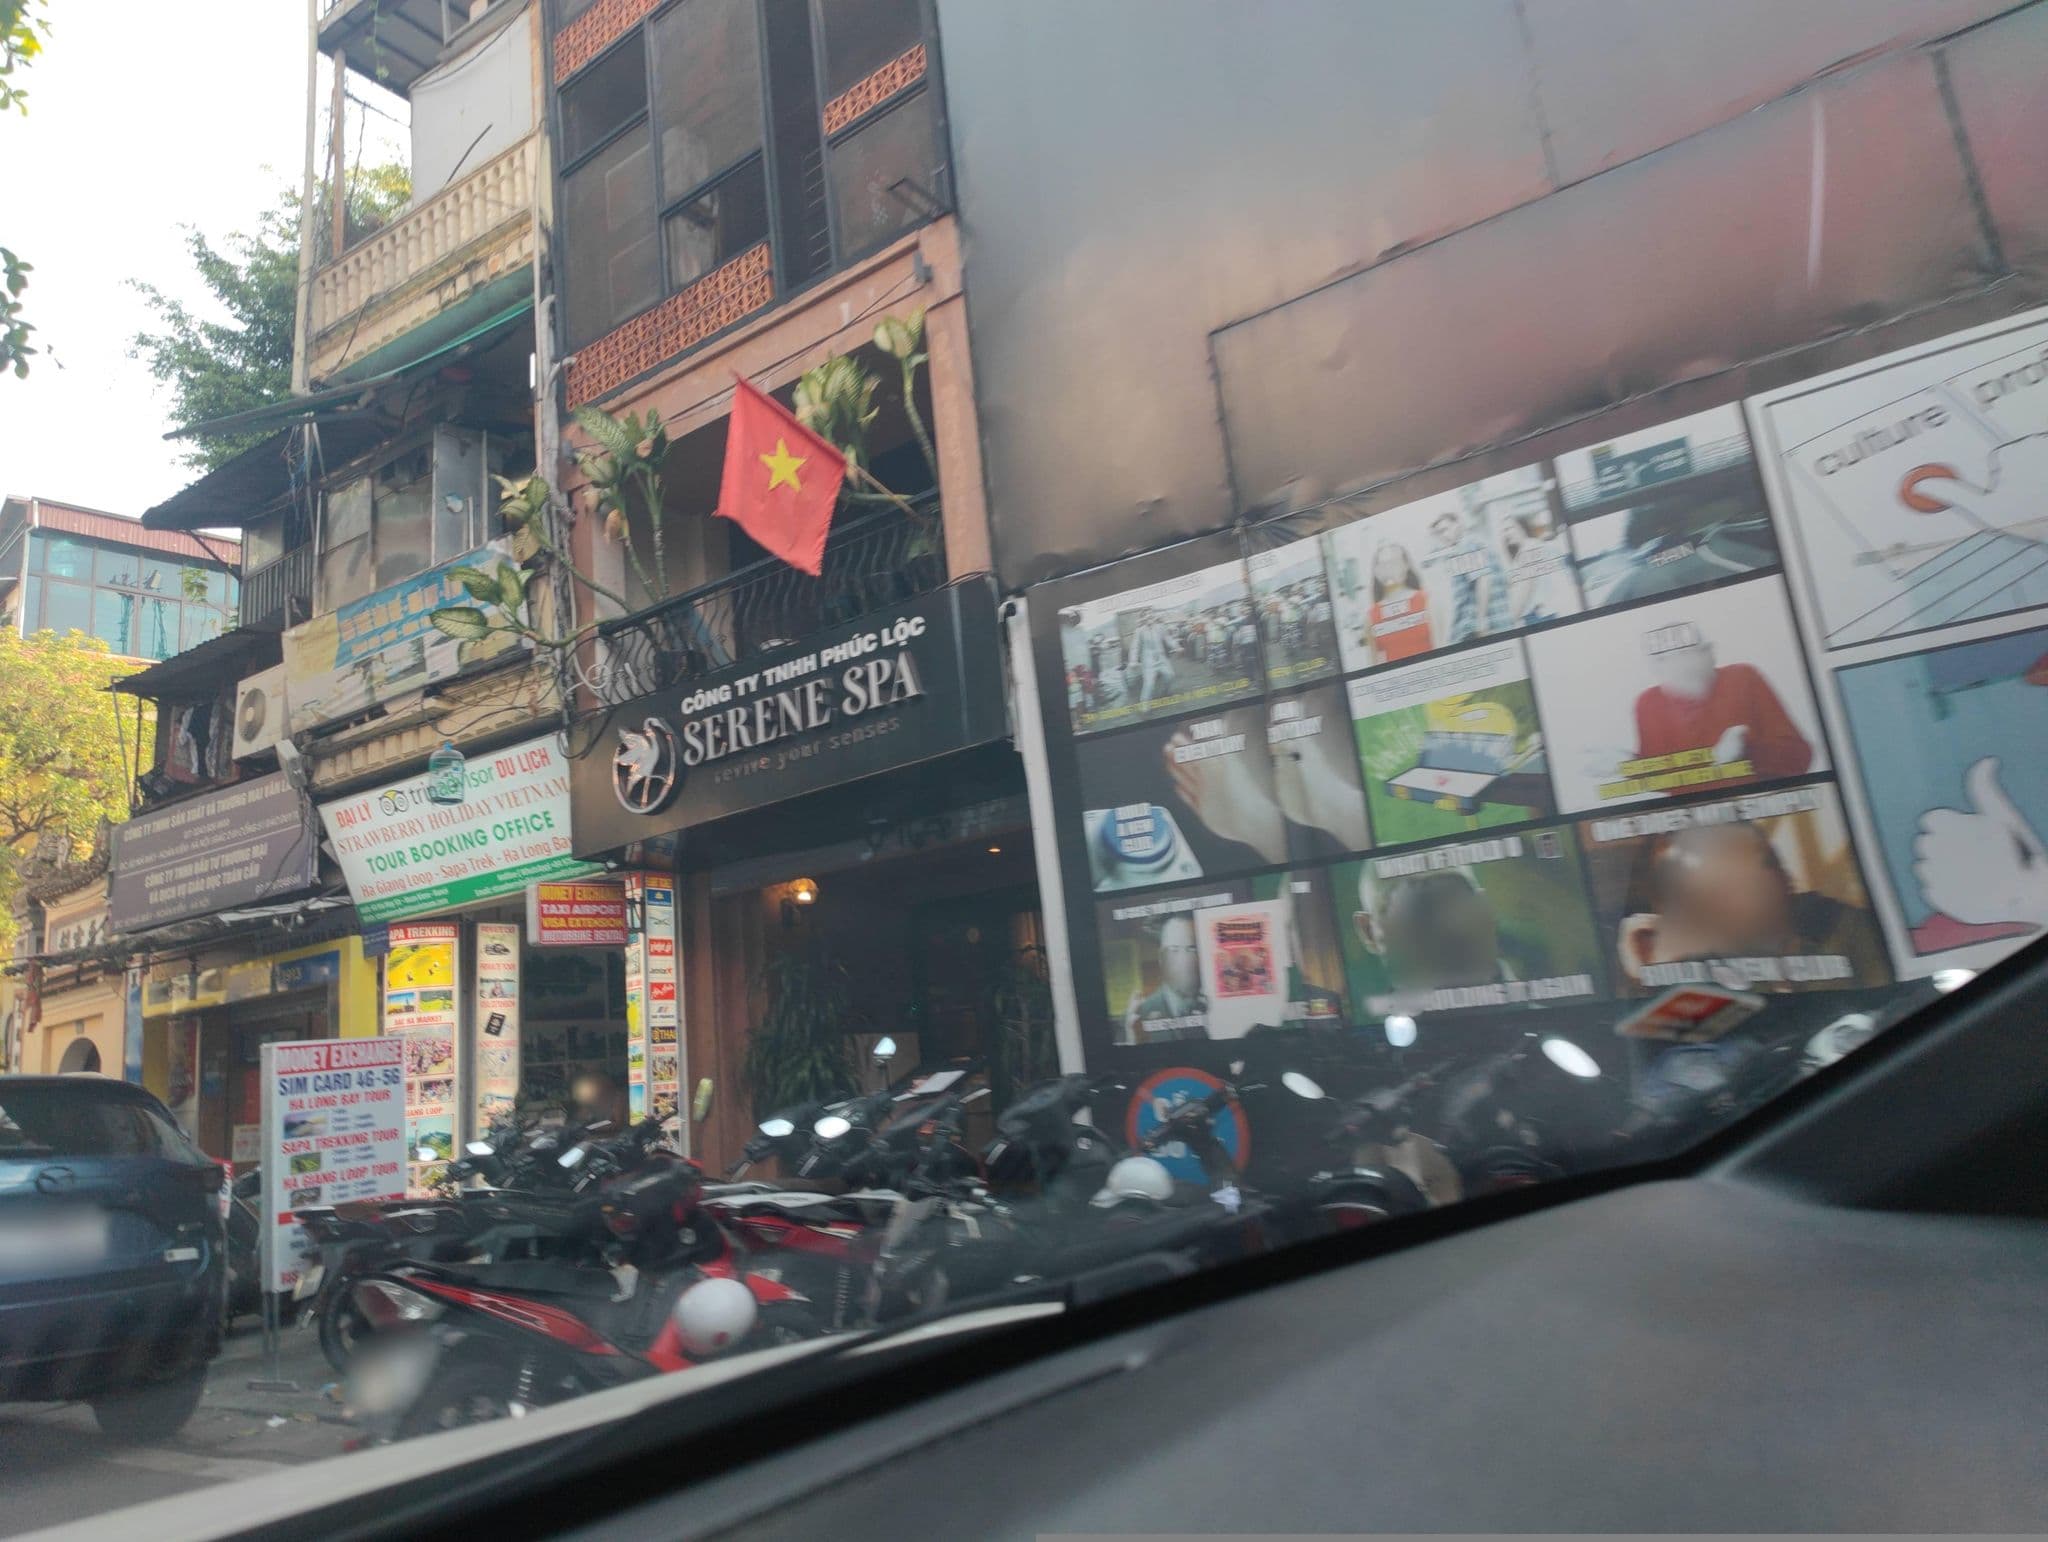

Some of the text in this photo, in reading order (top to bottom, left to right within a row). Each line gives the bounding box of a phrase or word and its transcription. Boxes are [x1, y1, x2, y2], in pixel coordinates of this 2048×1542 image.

[1813, 404, 1951, 478] culture
[681, 614, 927, 715] CÔNG TY TNHH PHÚC LỘC
[683, 650, 925, 768] SERENE SPA
[714, 717, 902, 786] revive your senses
[357, 800, 374, 821] LÝ
[495, 757, 517, 778] DU
[520, 747, 552, 774] LỊCH
[337, 815, 427, 855] STRAWBERRY
[428, 795, 494, 831] HOLIDAY
[493, 776, 570, 811] VIETNAM
[366, 810, 556, 875] TOUR BOOKING OFFICE
[360, 884, 377, 898] Ha
[376, 878, 407, 897] Giang
[404, 870, 434, 888] Loop
[439, 861, 468, 880] Sapa
[469, 854, 497, 872] Trek
[503, 848, 520, 864] Ha
[523, 842, 553, 860] Long
[542, 904, 622, 915] TAXI AIRPORT
[542, 917, 623, 928] VISA EXTENSION
[389, 926, 455, 939] APA TREKKING
[277, 1041, 401, 1074] MONEY EXCHANGE
[279, 1067, 400, 1097] SIM CARD 4G-5G
[288, 1088, 392, 1111] HA LONG BAY TOUR
[281, 1127, 400, 1154] SAPA TREKKING TOUR
[282, 1161, 400, 1191] HA GIANG LOOP TOUR
